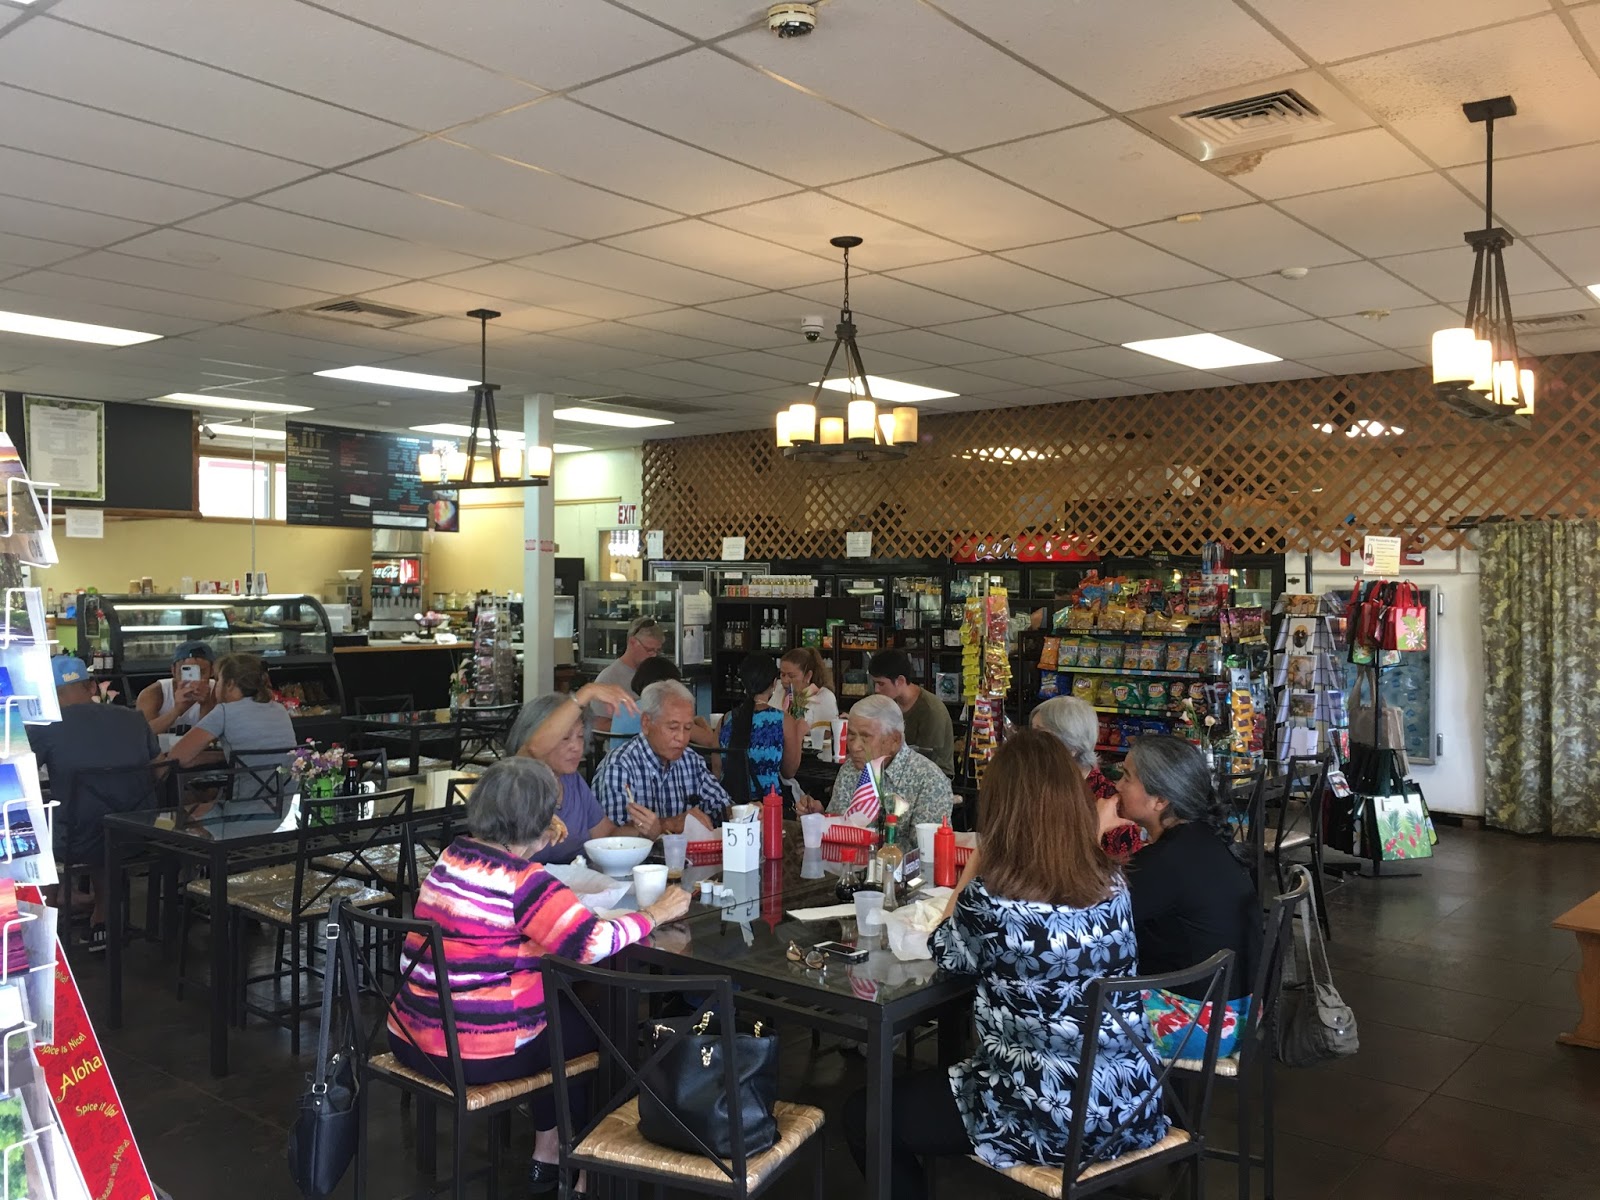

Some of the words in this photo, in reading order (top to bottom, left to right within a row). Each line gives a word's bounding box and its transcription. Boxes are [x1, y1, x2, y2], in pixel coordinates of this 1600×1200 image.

[618, 505, 637, 525] EXIT
[727, 828, 738, 847] 5
[746, 828, 755, 847] 5
[68, 1032, 87, 1050] Nice!
[55, 1055, 103, 1104] Aloha
[75, 1103, 98, 1117] Spice
[104, 1104, 119, 1118] Up!
